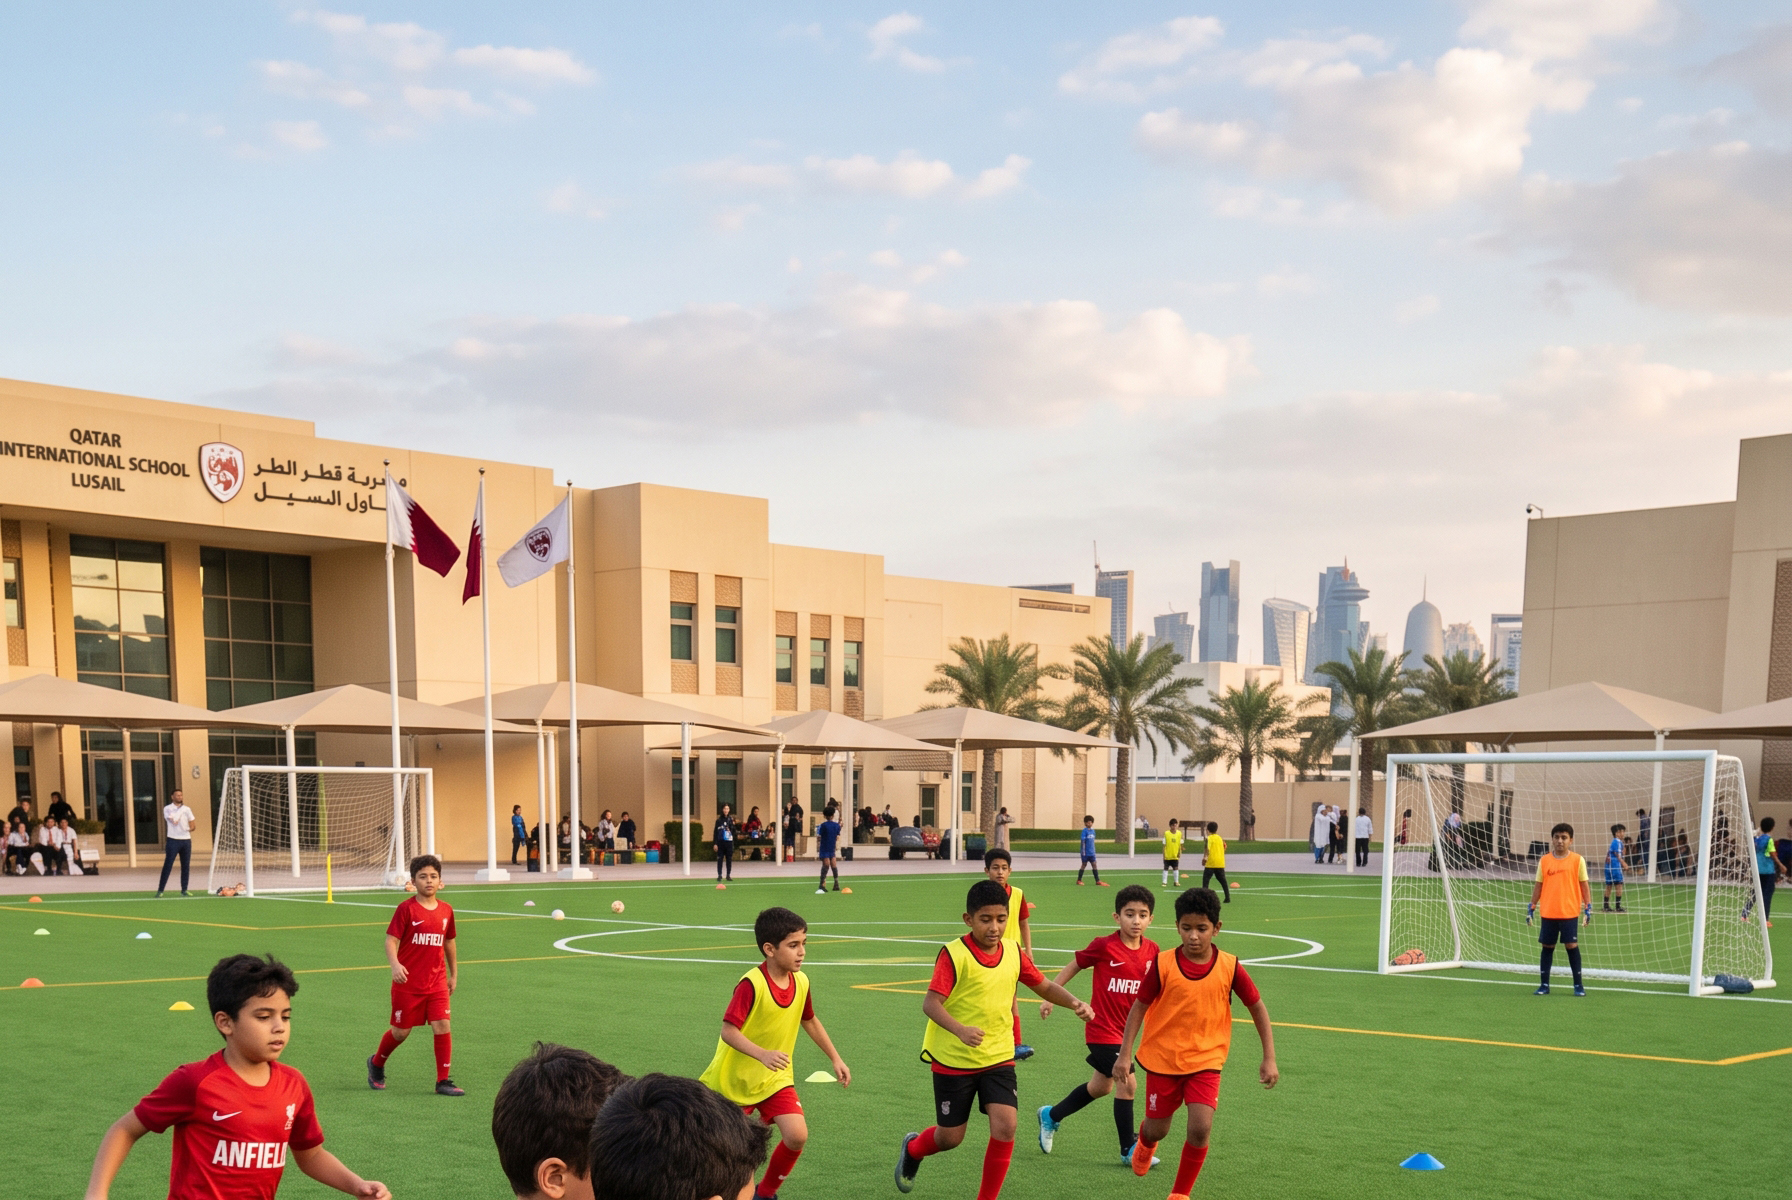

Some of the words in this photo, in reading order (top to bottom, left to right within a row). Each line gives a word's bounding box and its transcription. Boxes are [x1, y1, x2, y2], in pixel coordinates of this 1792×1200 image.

[70, 428, 121, 448] QATAR
[0, 441, 125, 470] INTERNATIONAL
[128, 457, 190, 477] SCHOOL
[71, 472, 125, 492] LUSAIL
